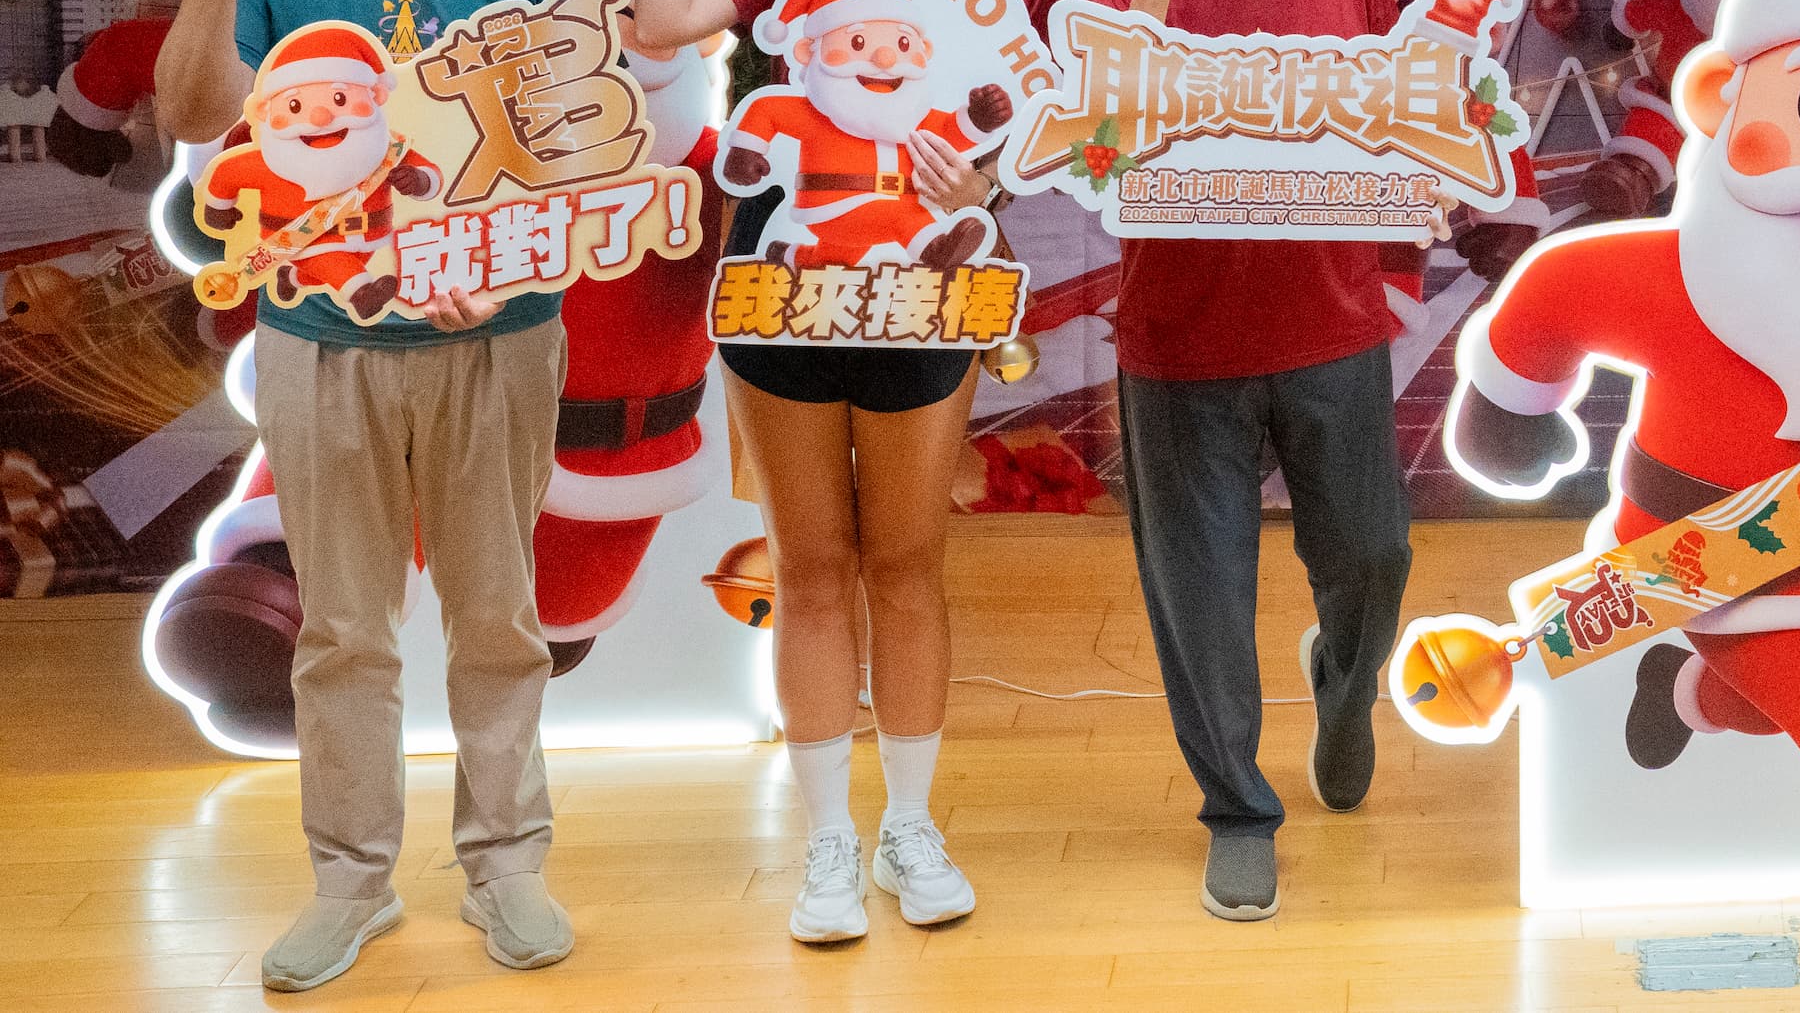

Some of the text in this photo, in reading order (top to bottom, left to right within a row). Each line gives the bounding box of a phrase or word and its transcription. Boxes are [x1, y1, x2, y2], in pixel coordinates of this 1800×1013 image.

[484, 14, 523, 33] 2026
[998, 34, 1055, 99] HO
[1016, 9, 1506, 199] 耶誕快追
[1121, 170, 1438, 206] 新北市耶誕馬拉松接力賽
[1121, 208, 1430, 226] 2026NEW TAIPEI CITY CHRISTMAS RELAY
[713, 262, 1023, 343] 我來接棒
